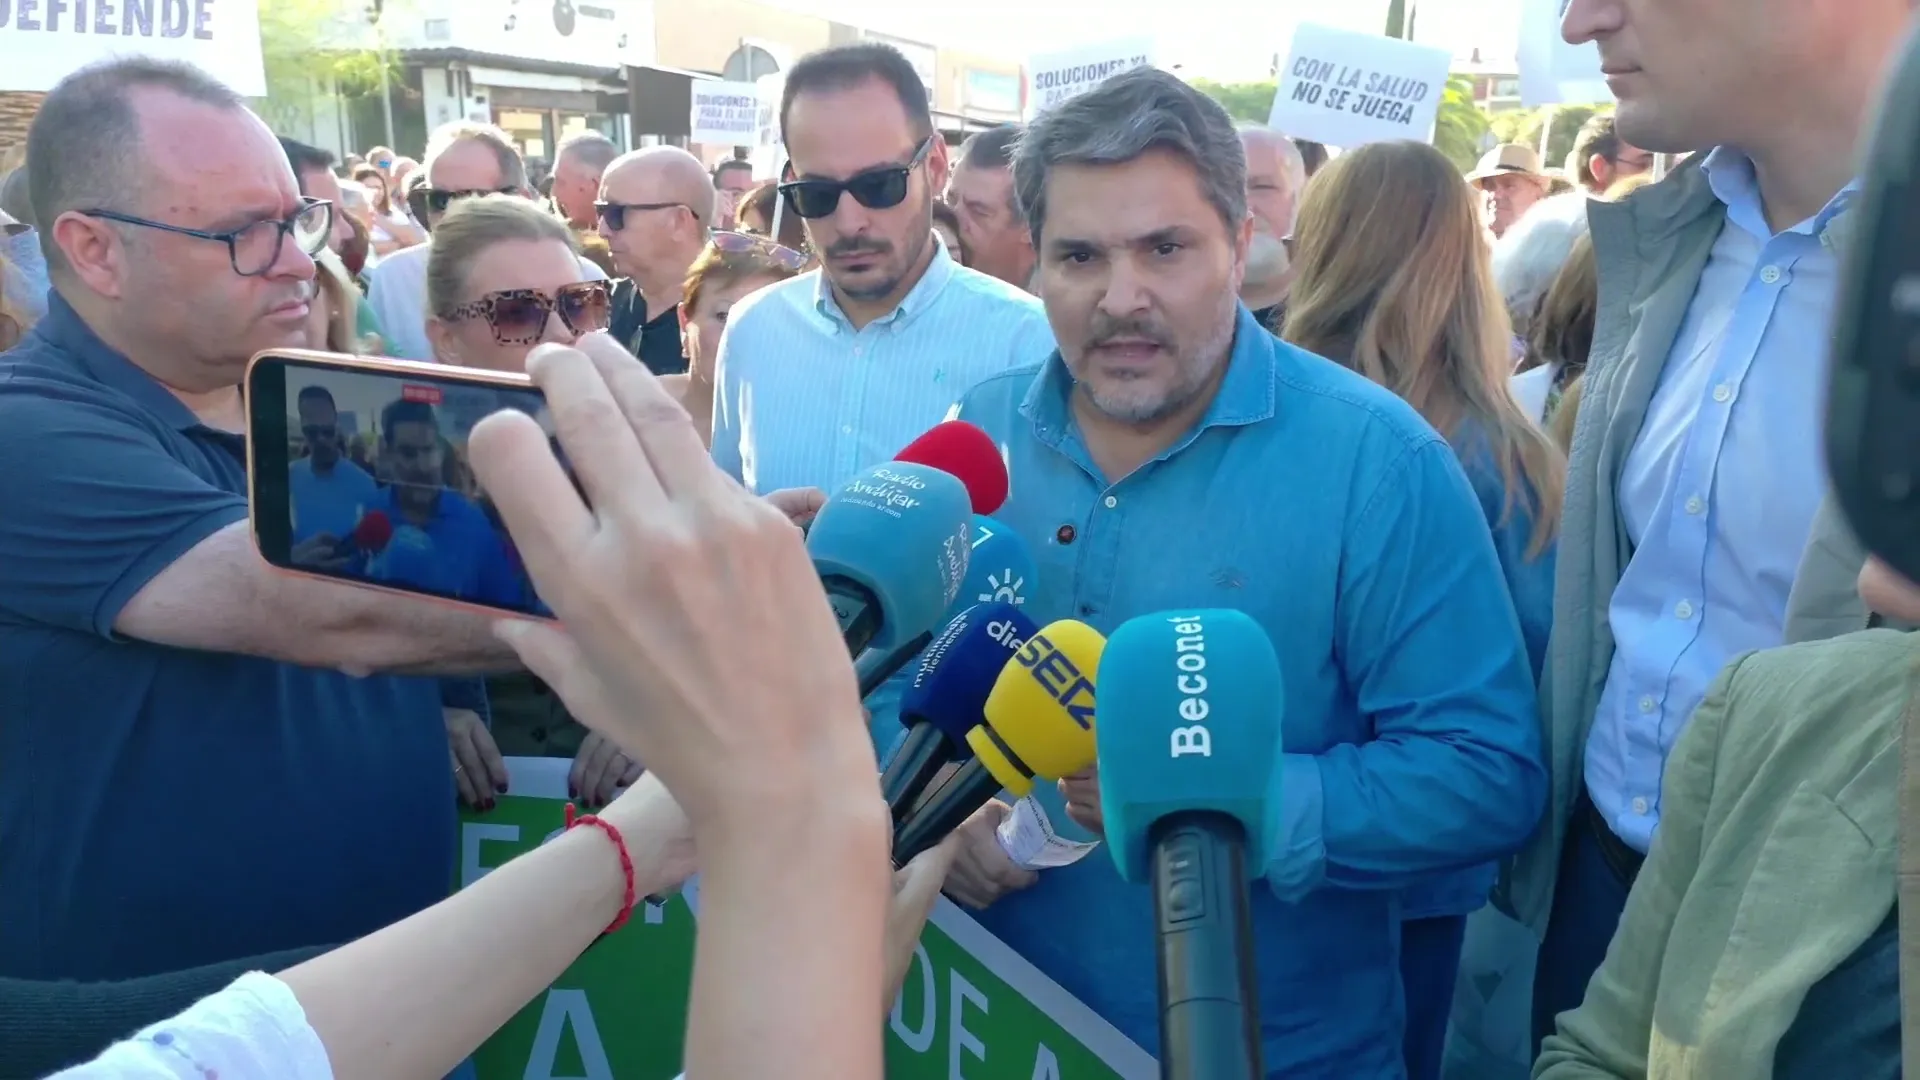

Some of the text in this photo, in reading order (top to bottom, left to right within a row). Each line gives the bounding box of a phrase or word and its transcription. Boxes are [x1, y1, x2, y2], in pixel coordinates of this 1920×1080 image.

[1292, 56, 1428, 103] CON LA SALUD
[1292, 81, 1415, 125] NO SE JUEGA
[872, 468, 926, 490] Radio
[986, 620, 1024, 651] die
[1166, 615, 1212, 758] Beconet
